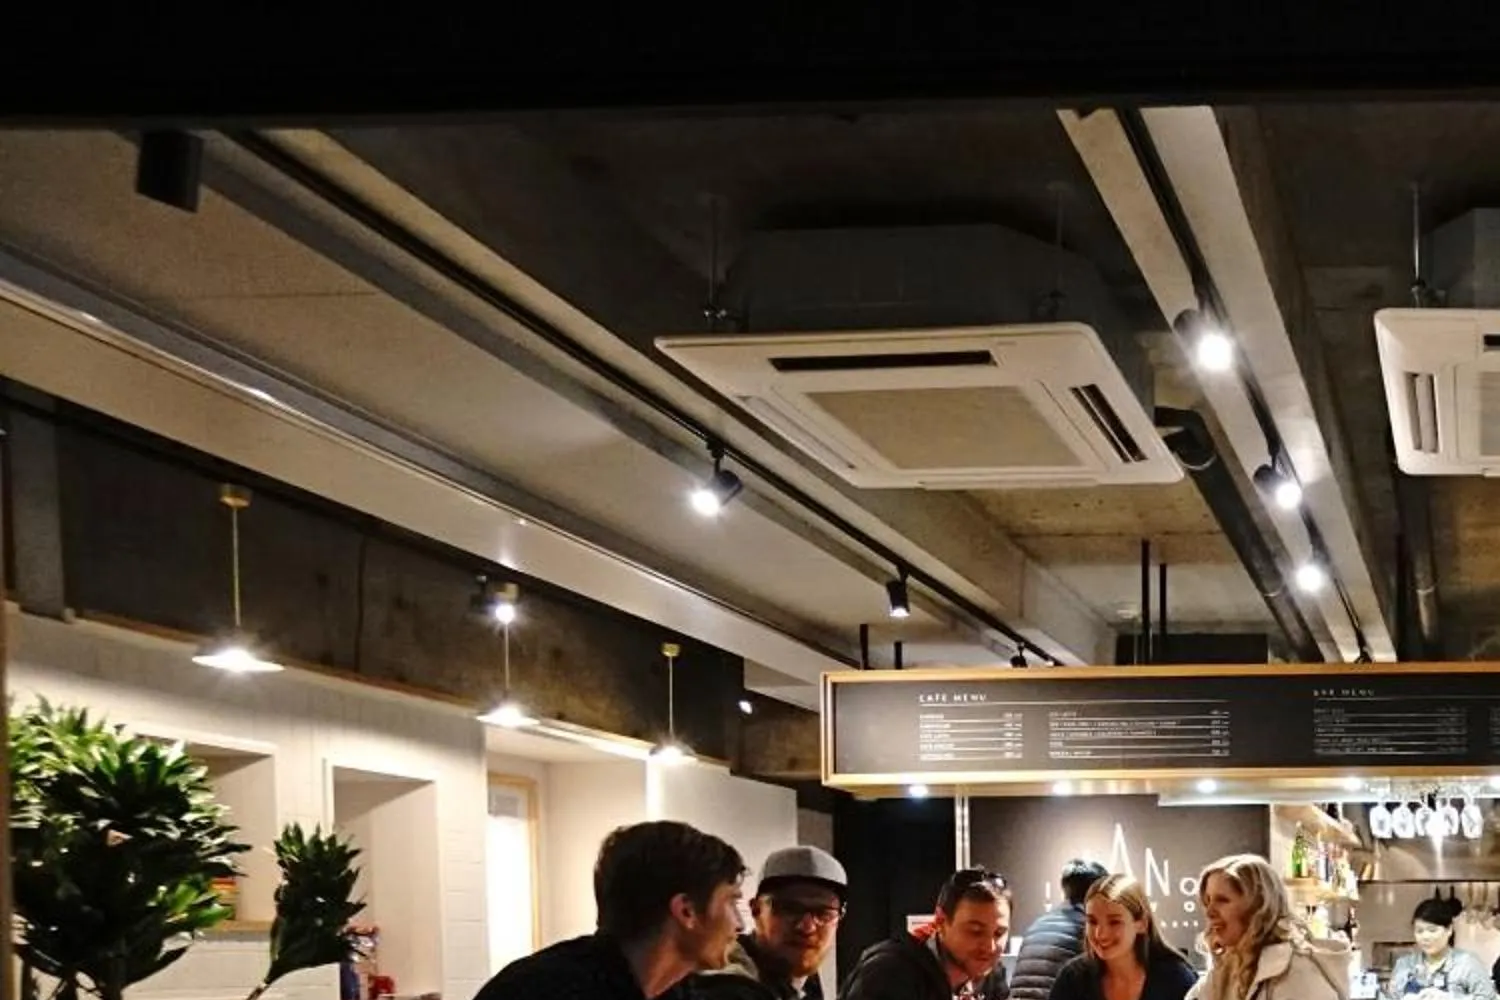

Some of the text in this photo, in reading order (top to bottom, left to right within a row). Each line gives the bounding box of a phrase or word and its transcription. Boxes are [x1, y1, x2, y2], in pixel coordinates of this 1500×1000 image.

[919, 692, 988, 703] CAFE MENU
[1341, 688, 1375, 697] MENU
